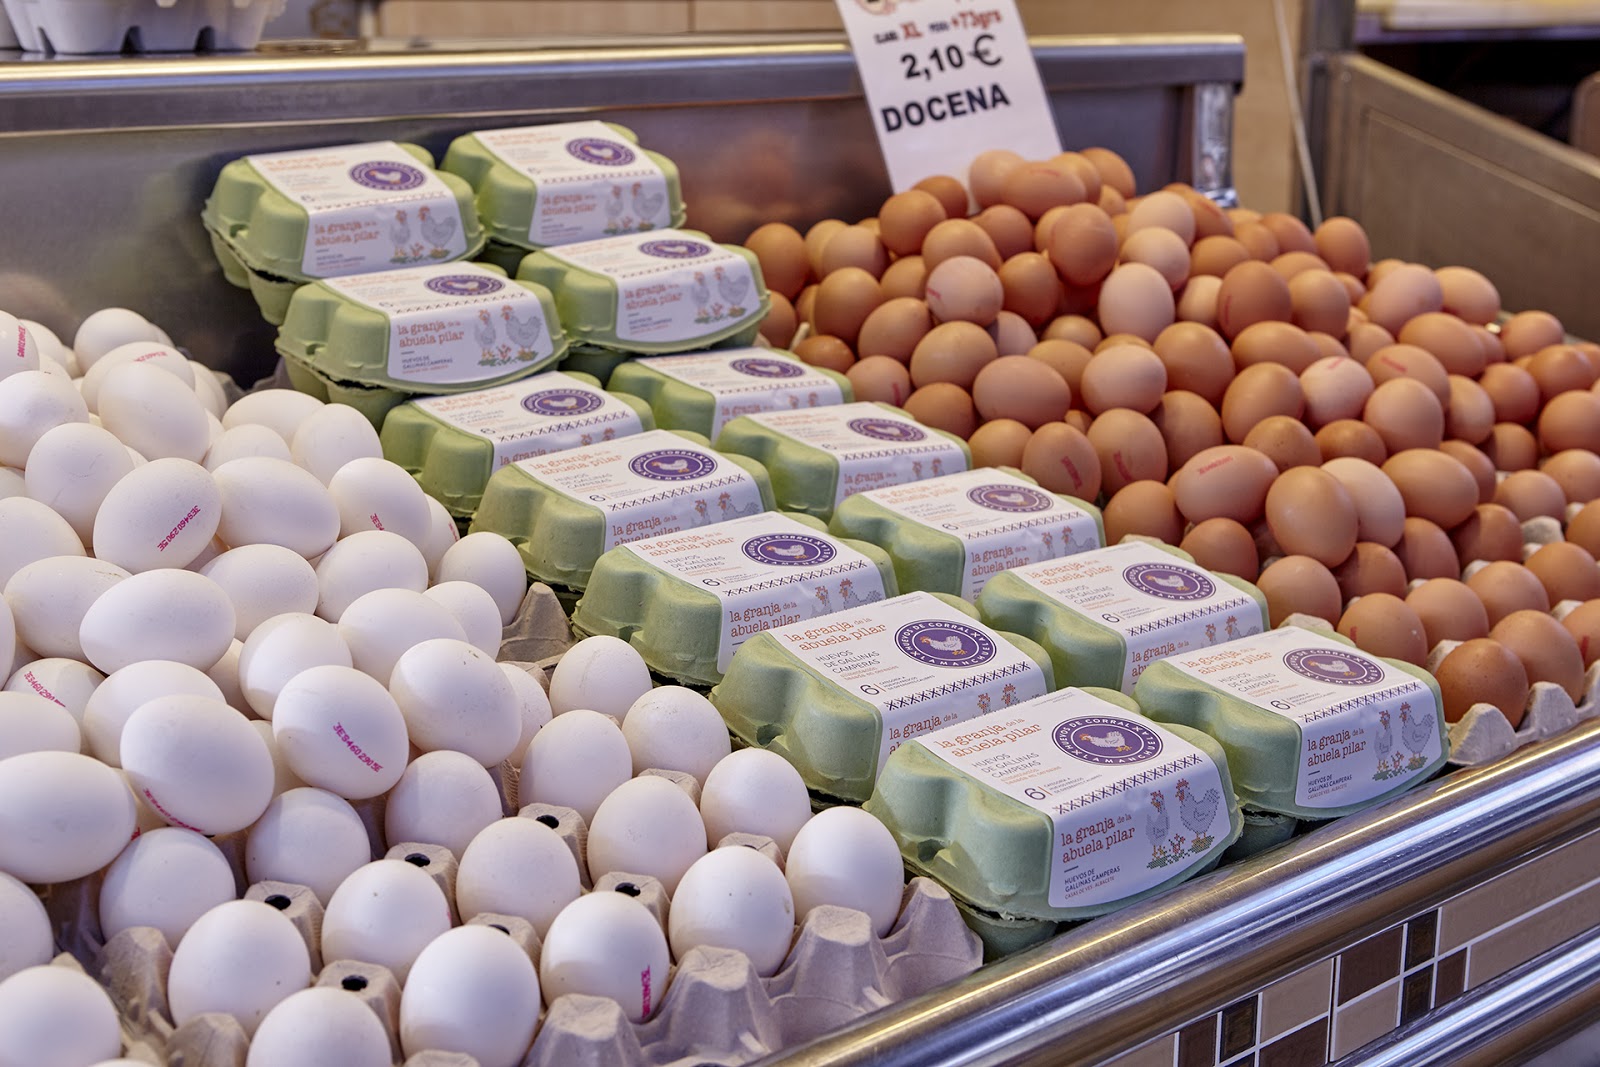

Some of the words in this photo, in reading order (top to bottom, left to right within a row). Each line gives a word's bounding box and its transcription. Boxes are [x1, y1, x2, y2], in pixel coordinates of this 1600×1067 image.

[881, 83, 1010, 132] DOCENA
[397, 324, 408, 335] la
[411, 320, 446, 336] granja
[400, 334, 436, 348] abuela
[438, 332, 464, 344] pilar
[612, 526, 624, 536] la
[626, 516, 662, 535] granja
[650, 544, 700, 556] abuela
[700, 537, 735, 549] pilar
[656, 533, 704, 548] granja
[971, 552, 981, 563] la
[983, 546, 1014, 563] granja
[972, 561, 1004, 576] abuela
[1084, 565, 1113, 577] pilar
[730, 611, 741, 622] la
[744, 602, 781, 622] granja
[1102, 614, 1120, 623] 6
[731, 620, 770, 637] abuela
[772, 614, 800, 629] pilar
[784, 634, 804, 642] la
[804, 621, 854, 640] granja
[928, 622, 970, 633] CORRAL
[799, 634, 851, 651] abuela
[850, 624, 887, 640] pilar
[816, 650, 853, 662] HUEVOS
[841, 651, 880, 665] GALLINAS
[1132, 652, 1142, 662] la
[1144, 642, 1176, 662] granja
[1198, 651, 1241, 666] granja
[832, 659, 880, 674] CAMPERAS
[1198, 661, 1244, 675] abuela
[1242, 652, 1272, 665] pilar
[860, 684, 880, 695] 6
[1271, 700, 1290, 710] 6
[890, 728, 901, 740] la
[903, 716, 942, 739] granja
[955, 724, 1006, 745] granja
[1060, 727, 1074, 750] HUEVOS
[1085, 718, 1130, 728] CORRAL
[952, 738, 1005, 757] abuela
[1003, 723, 1041, 742] pilar
[1308, 739, 1317, 751] la
[1319, 730, 1351, 750] granja
[972, 753, 1010, 767] HUEVOS
[996, 753, 1039, 770] GALLINAS
[1308, 748, 1340, 767] abuela
[1342, 741, 1366, 759] pilar
[992, 760, 1041, 778] CAMPERAS
[1308, 776, 1326, 786] HUEVOS
[1308, 782, 1329, 794] GALLINAS
[1329, 774, 1352, 786] CAMPERAS
[1024, 788, 1046, 800] 6
[1061, 833, 1074, 846] la
[1076, 817, 1116, 844] granja
[1062, 839, 1103, 864] abuela
[1106, 827, 1135, 850] pilar
[1065, 871, 1087, 885] HUEVOS
[1088, 868, 1095, 877] DE
[1065, 879, 1091, 892] GALLINAS
[1092, 866, 1120, 882] CAMPERAS
